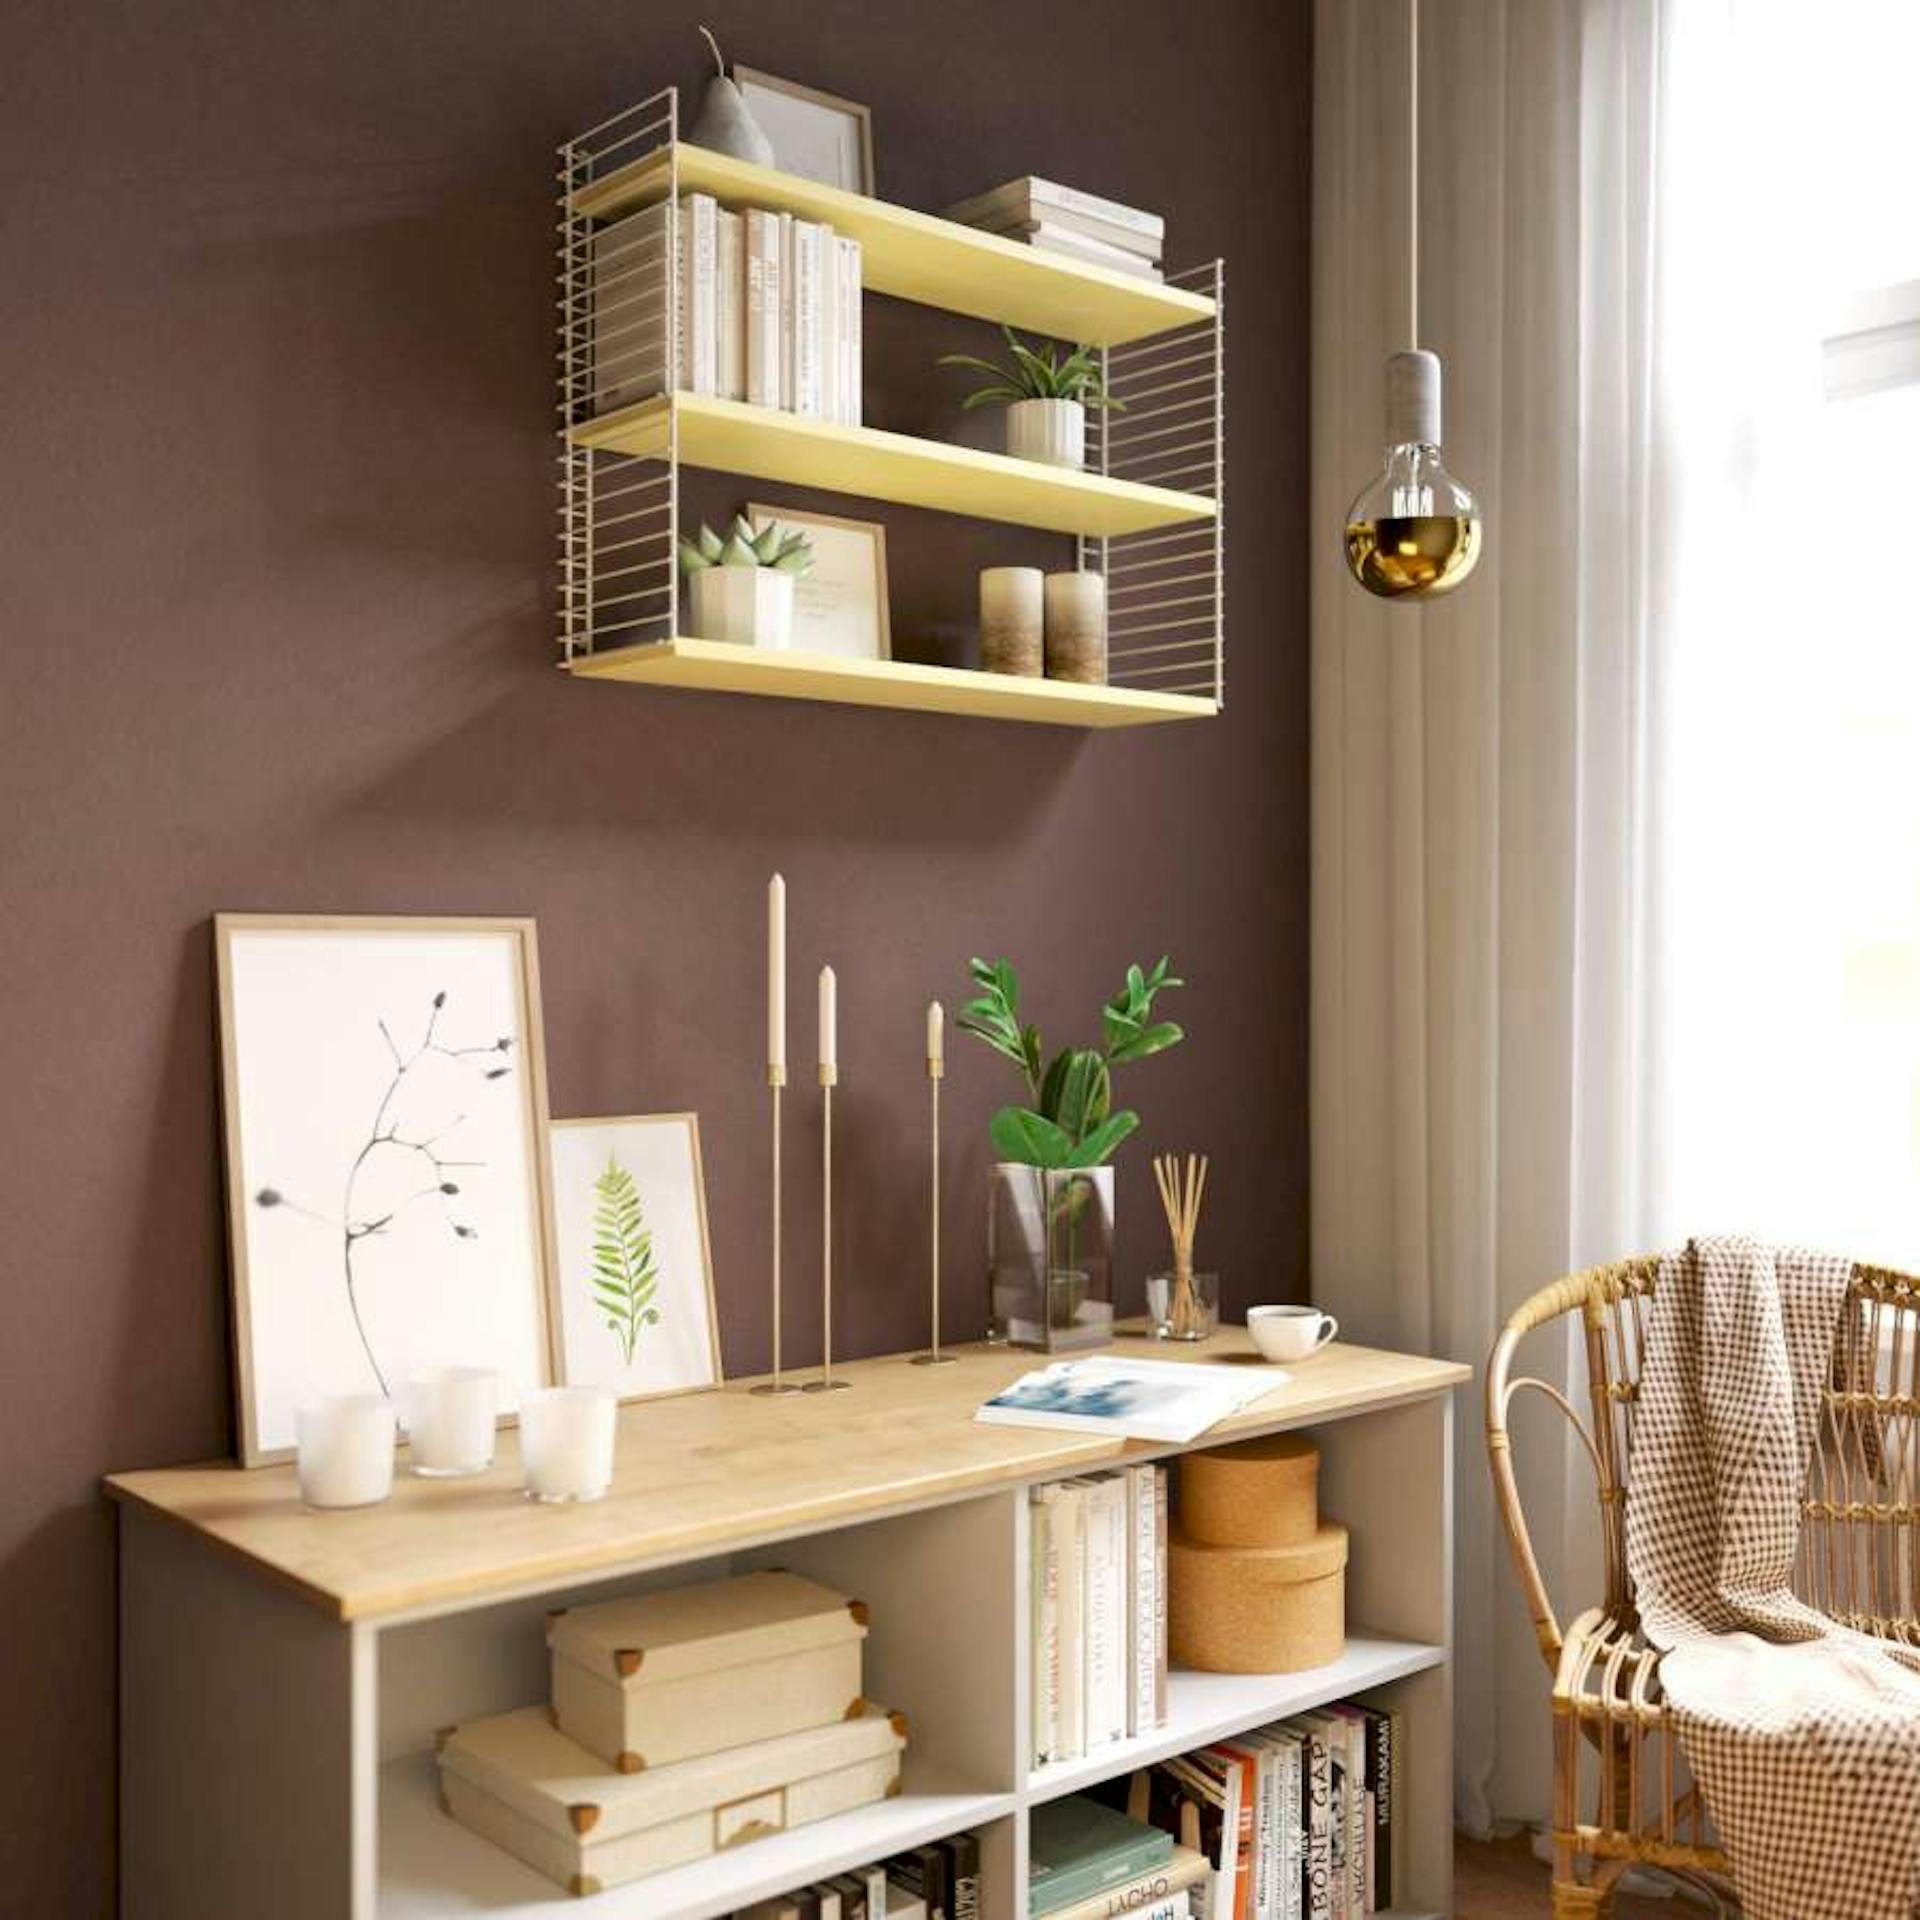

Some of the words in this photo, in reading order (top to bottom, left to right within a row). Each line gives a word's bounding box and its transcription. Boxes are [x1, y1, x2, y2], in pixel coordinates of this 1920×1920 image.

[1311, 1741, 1328, 1808] GAP
[1377, 1720, 1389, 1826] MURAKAMI
[1311, 1821, 1328, 1912] BONE
